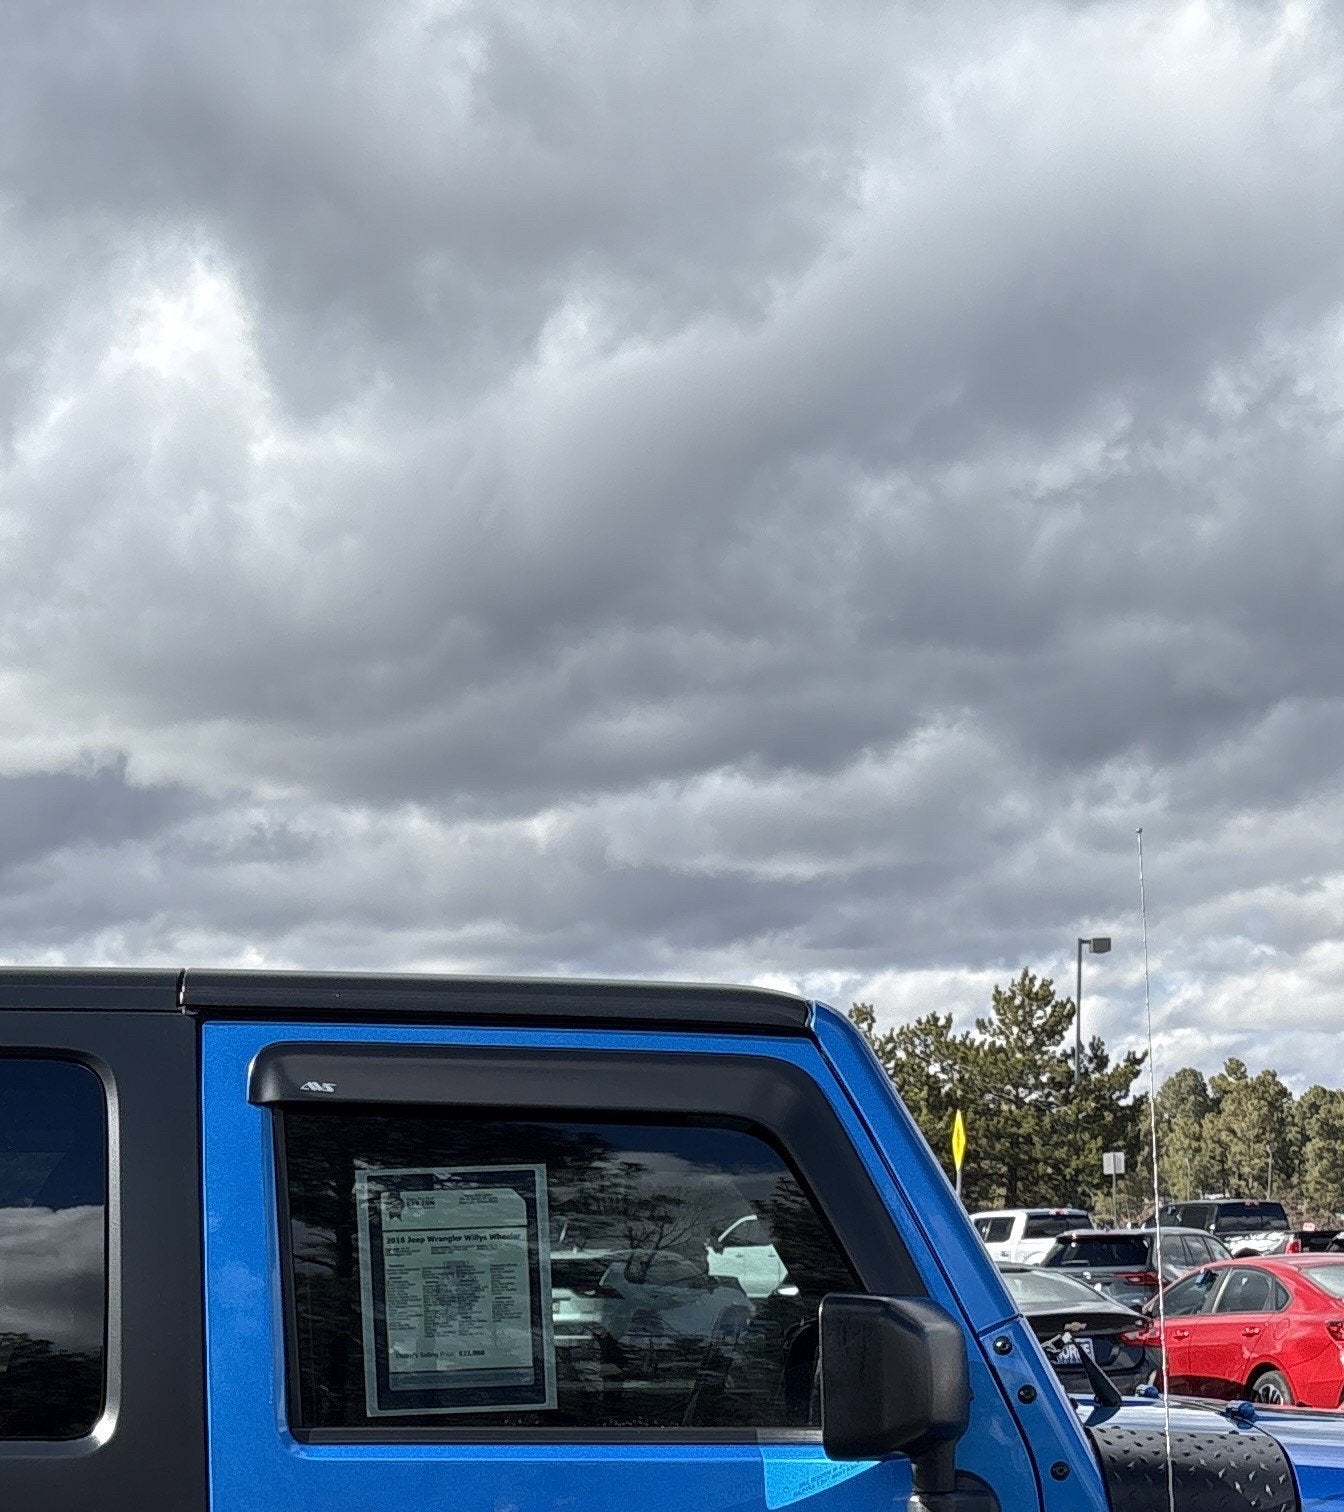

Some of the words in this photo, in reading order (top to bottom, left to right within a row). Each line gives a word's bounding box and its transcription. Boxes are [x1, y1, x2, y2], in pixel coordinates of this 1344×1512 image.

[407, 1236, 426, 1245] Jeep
[427, 1235, 462, 1244] Wrangler
[464, 1233, 488, 1242] Willys
